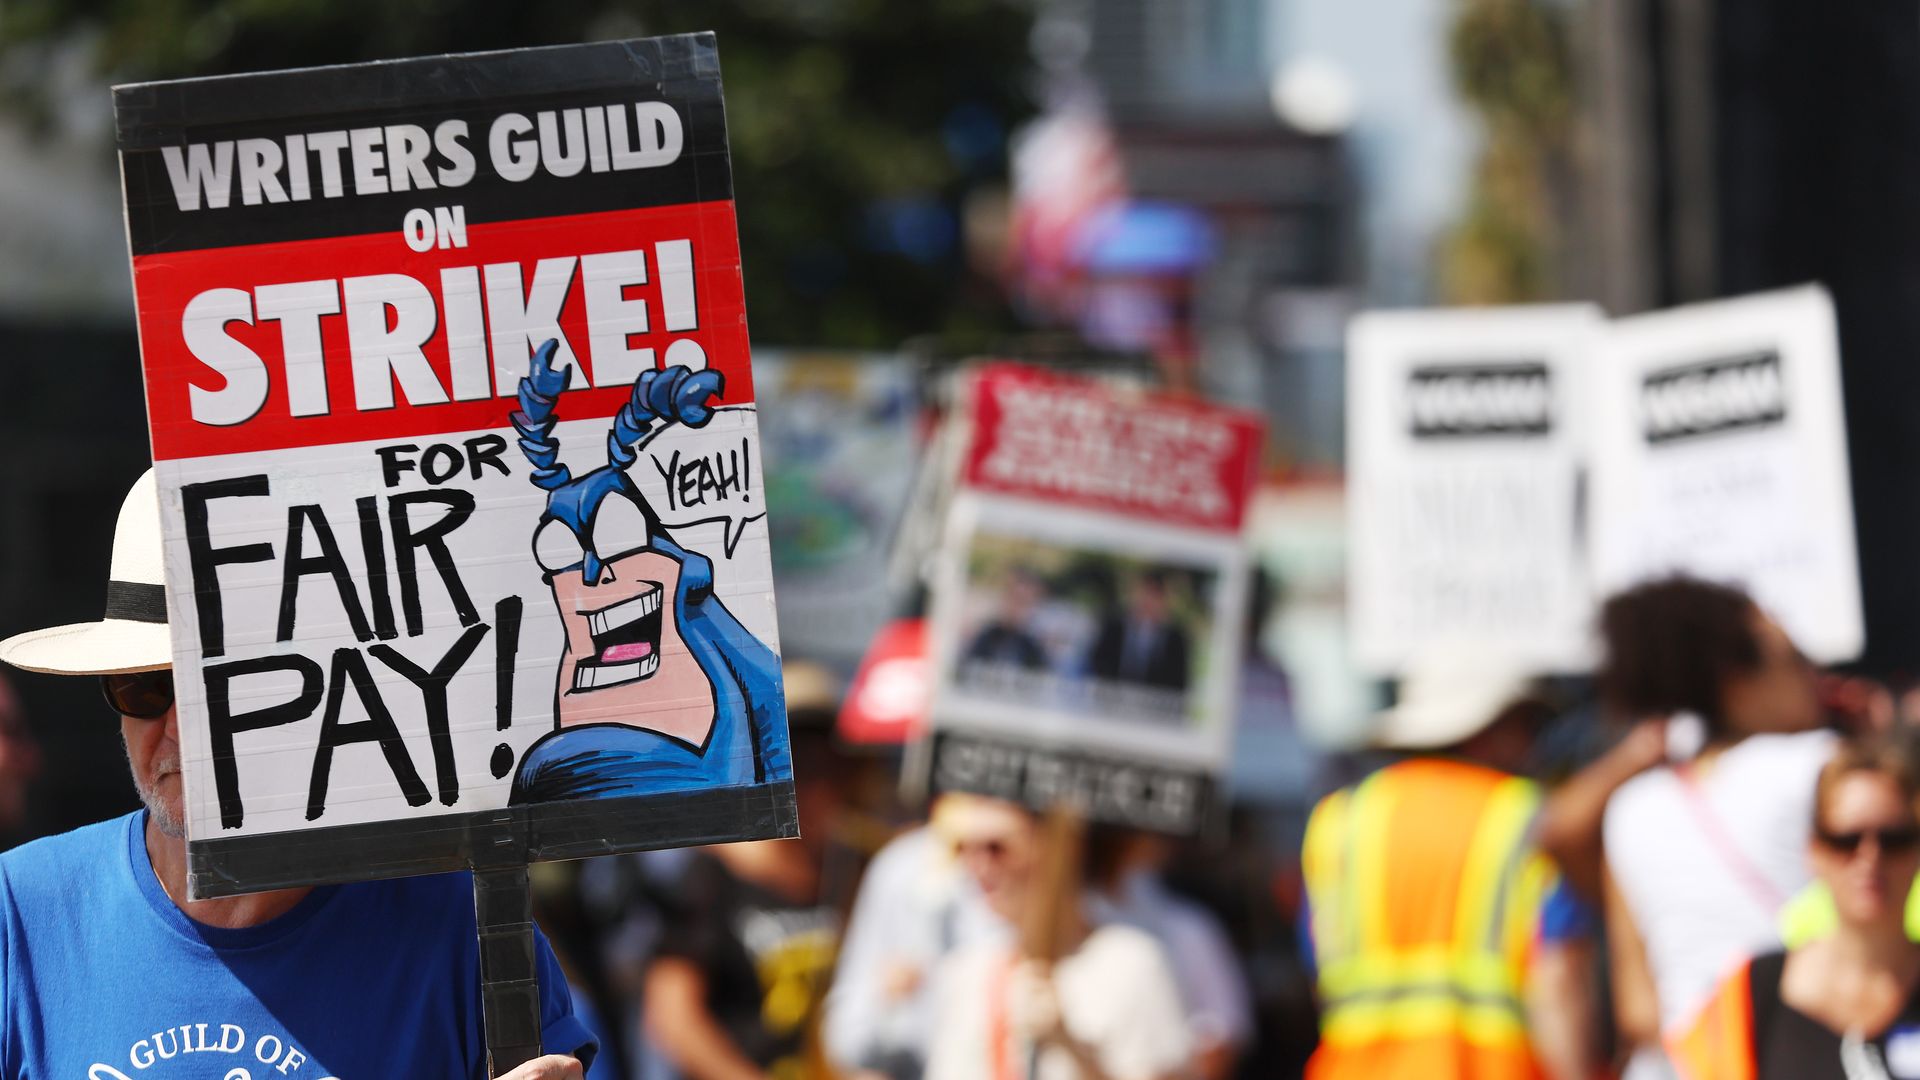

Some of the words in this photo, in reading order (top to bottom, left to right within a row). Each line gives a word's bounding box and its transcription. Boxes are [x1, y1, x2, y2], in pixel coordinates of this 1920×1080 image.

[161, 119, 476, 212] WRITERS
[488, 100, 684, 183] GUILD
[403, 205, 468, 253] ON
[181, 238, 707, 427] STRIKE!
[375, 433, 511, 487] FOR
[654, 437, 750, 511] YEAH!
[180, 473, 481, 659] FAIR
[203, 594, 522, 830] PAY!
[130, 1023, 246, 1069] GUILD
[255, 1034, 307, 1075] OF
